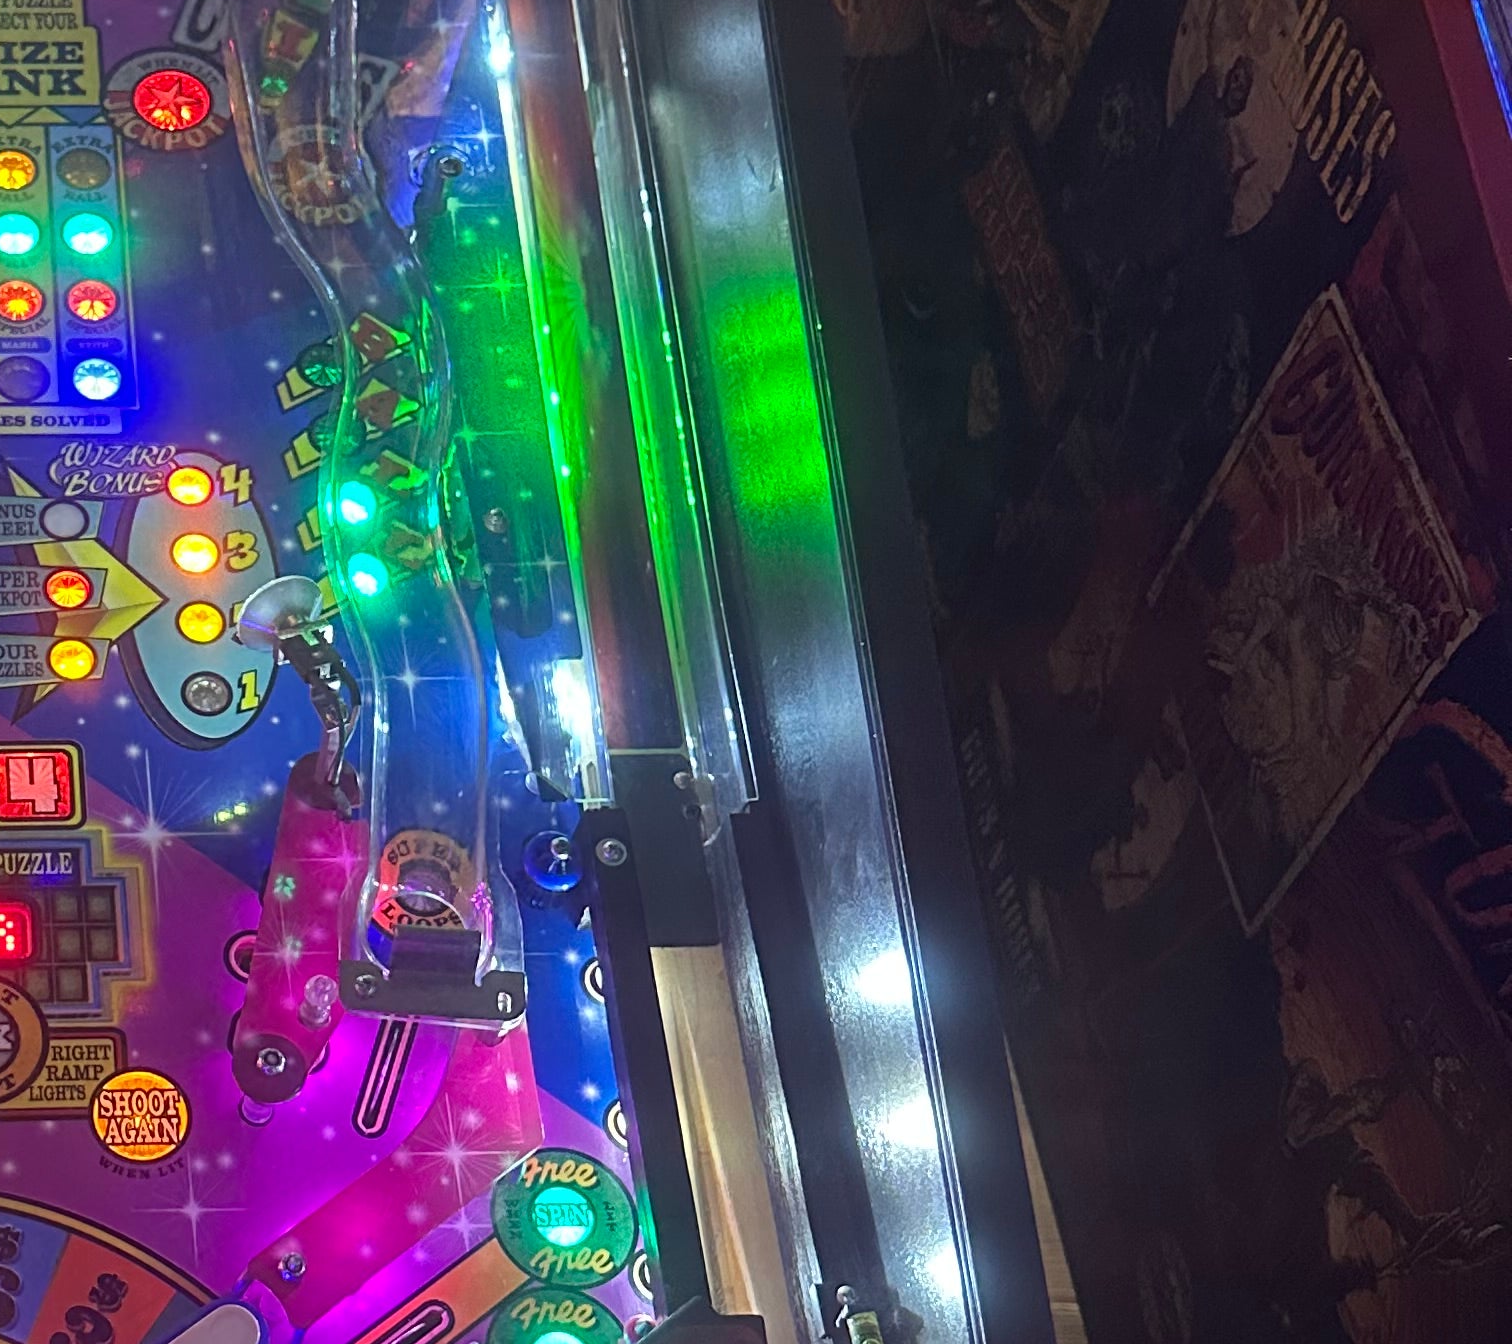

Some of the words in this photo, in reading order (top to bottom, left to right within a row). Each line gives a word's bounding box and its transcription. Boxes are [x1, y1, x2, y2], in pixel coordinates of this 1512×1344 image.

[33, 12, 78, 31] YOUR
[103, 96, 226, 151] JACKPOT
[52, 135, 112, 155] EXTRA
[30, 413, 111, 428] SOLVED
[59, 442, 178, 468] WIZARD
[64, 470, 165, 497] BONUS
[219, 463, 253, 504] 4
[223, 529, 260, 571] 3
[237, 669, 261, 713] 1
[6, 755, 61, 815] 4
[51, 1044, 112, 1061] RIGHT
[45, 1064, 105, 1081] RAMP
[28, 1084, 87, 1102] LIGHTS
[98, 1089, 184, 1117] SHOOT
[105, 1117, 181, 1146] AGAIN
[98, 1156, 151, 1180] WHEN
[155, 1155, 188, 1175] LIT
[524, 1157, 599, 1188] Free
[535, 1203, 588, 1227] SPIN
[530, 1246, 615, 1279] Free
[510, 1297, 597, 1330] Free
